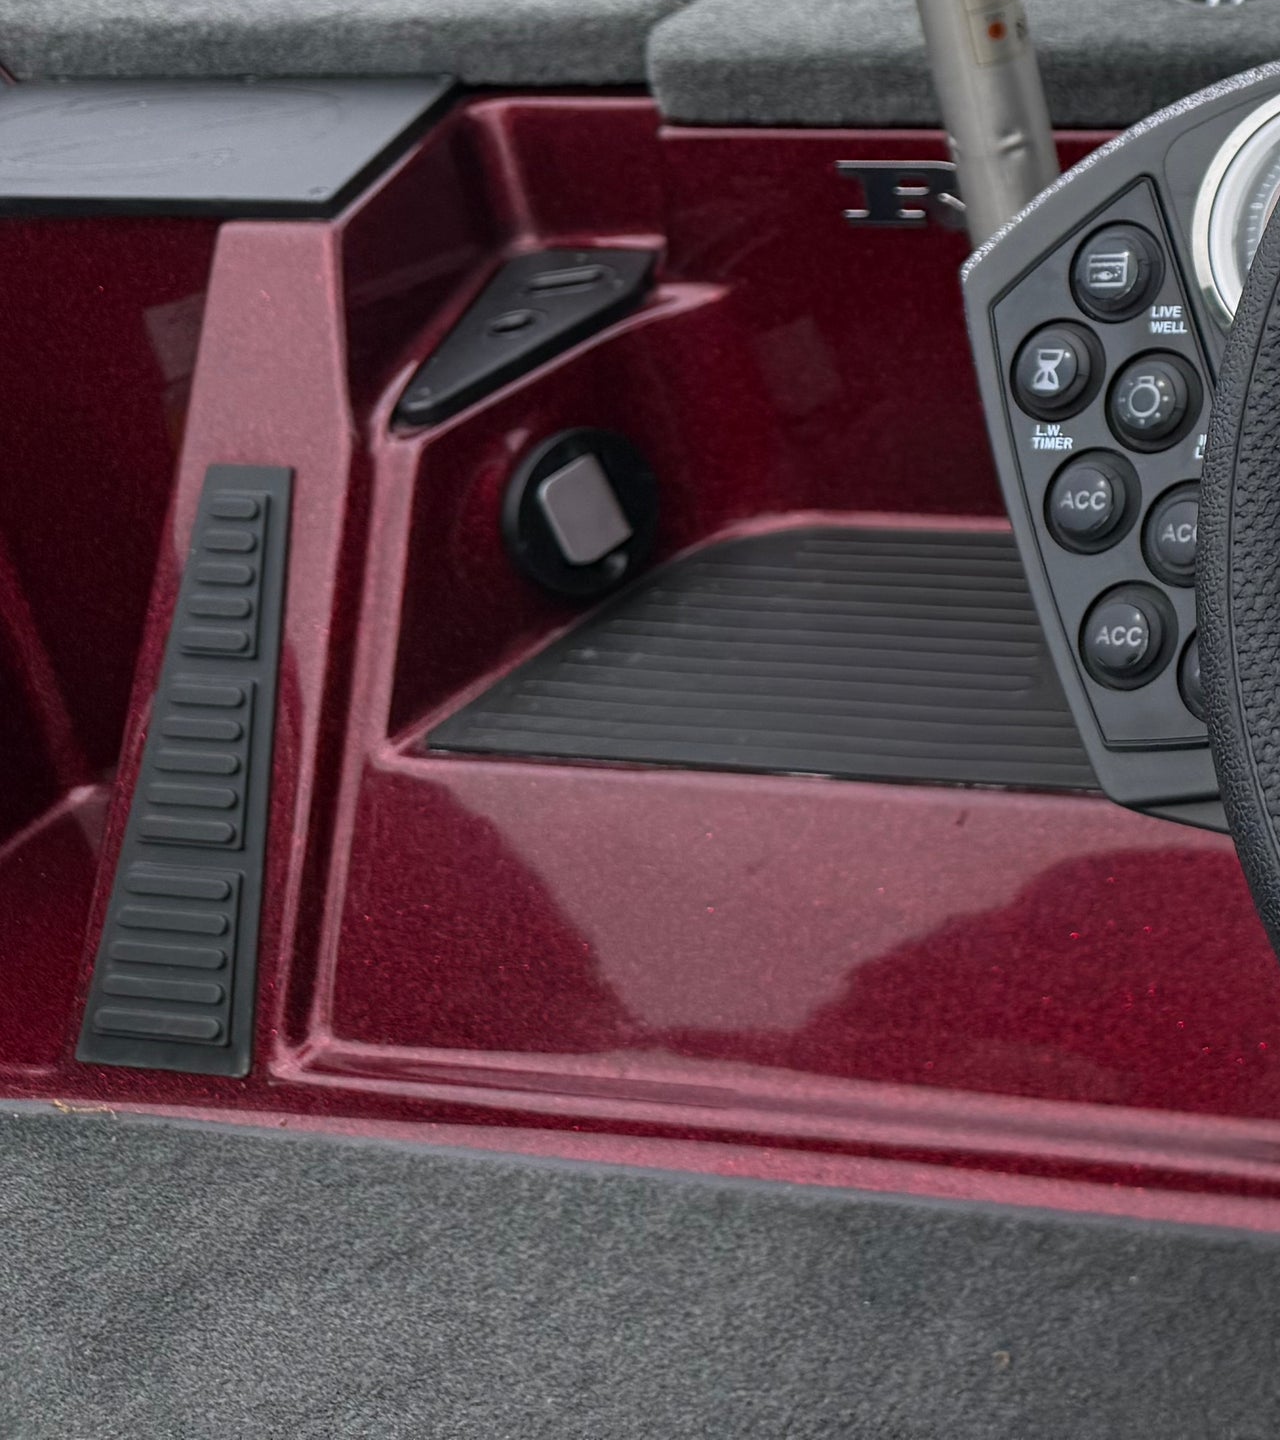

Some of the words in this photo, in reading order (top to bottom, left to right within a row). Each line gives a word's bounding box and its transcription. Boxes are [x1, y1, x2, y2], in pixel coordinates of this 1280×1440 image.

[1151, 305, 1183, 318] LIVE
[1150, 320, 1188, 334] WELL
[1035, 424, 1063, 436] L.W.
[1032, 436, 1073, 450] TIMER
[1060, 490, 1107, 510] ACC
[1096, 625, 1143, 646] ACC
